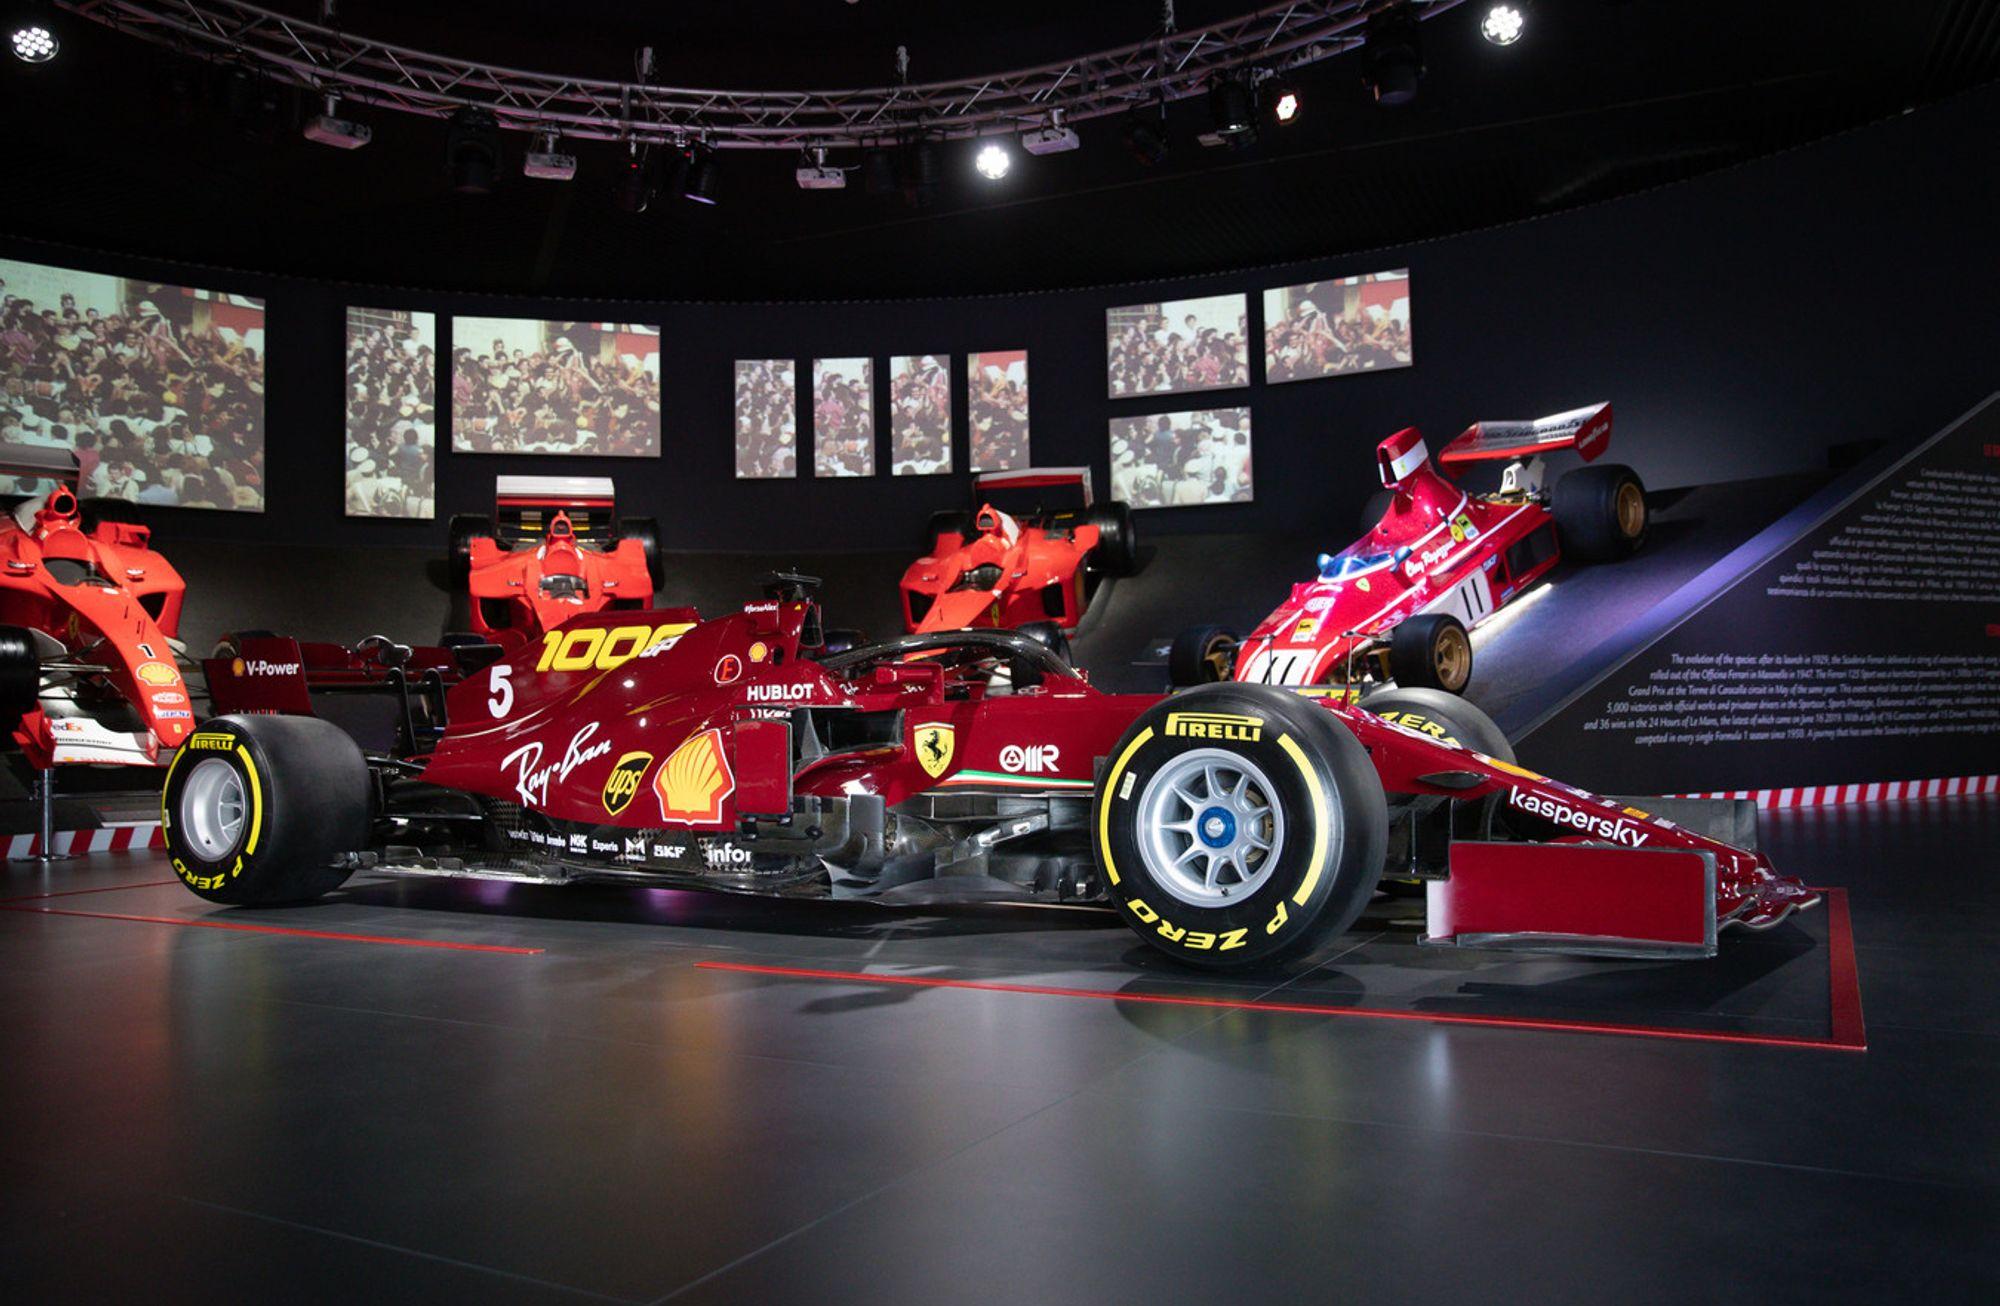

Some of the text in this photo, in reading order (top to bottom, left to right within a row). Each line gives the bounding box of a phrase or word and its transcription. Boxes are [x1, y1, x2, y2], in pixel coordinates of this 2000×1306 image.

[138, 644, 154, 659] 1
[246, 660, 299, 676] V-Power
[488, 664, 513, 719] 5
[747, 684, 814, 702] HUBLOT
[52, 723, 83, 732] edEx
[1164, 712, 1265, 743] PIRELLI
[190, 732, 236, 751] PIRELLI
[607, 769, 643, 806] ups
[1509, 784, 1649, 849] kaspersky
[653, 845, 687, 860] SKF
[707, 842, 752, 864] infor
[172, 854, 244, 890] P ZERO
[1127, 898, 1290, 952] P ZERO
